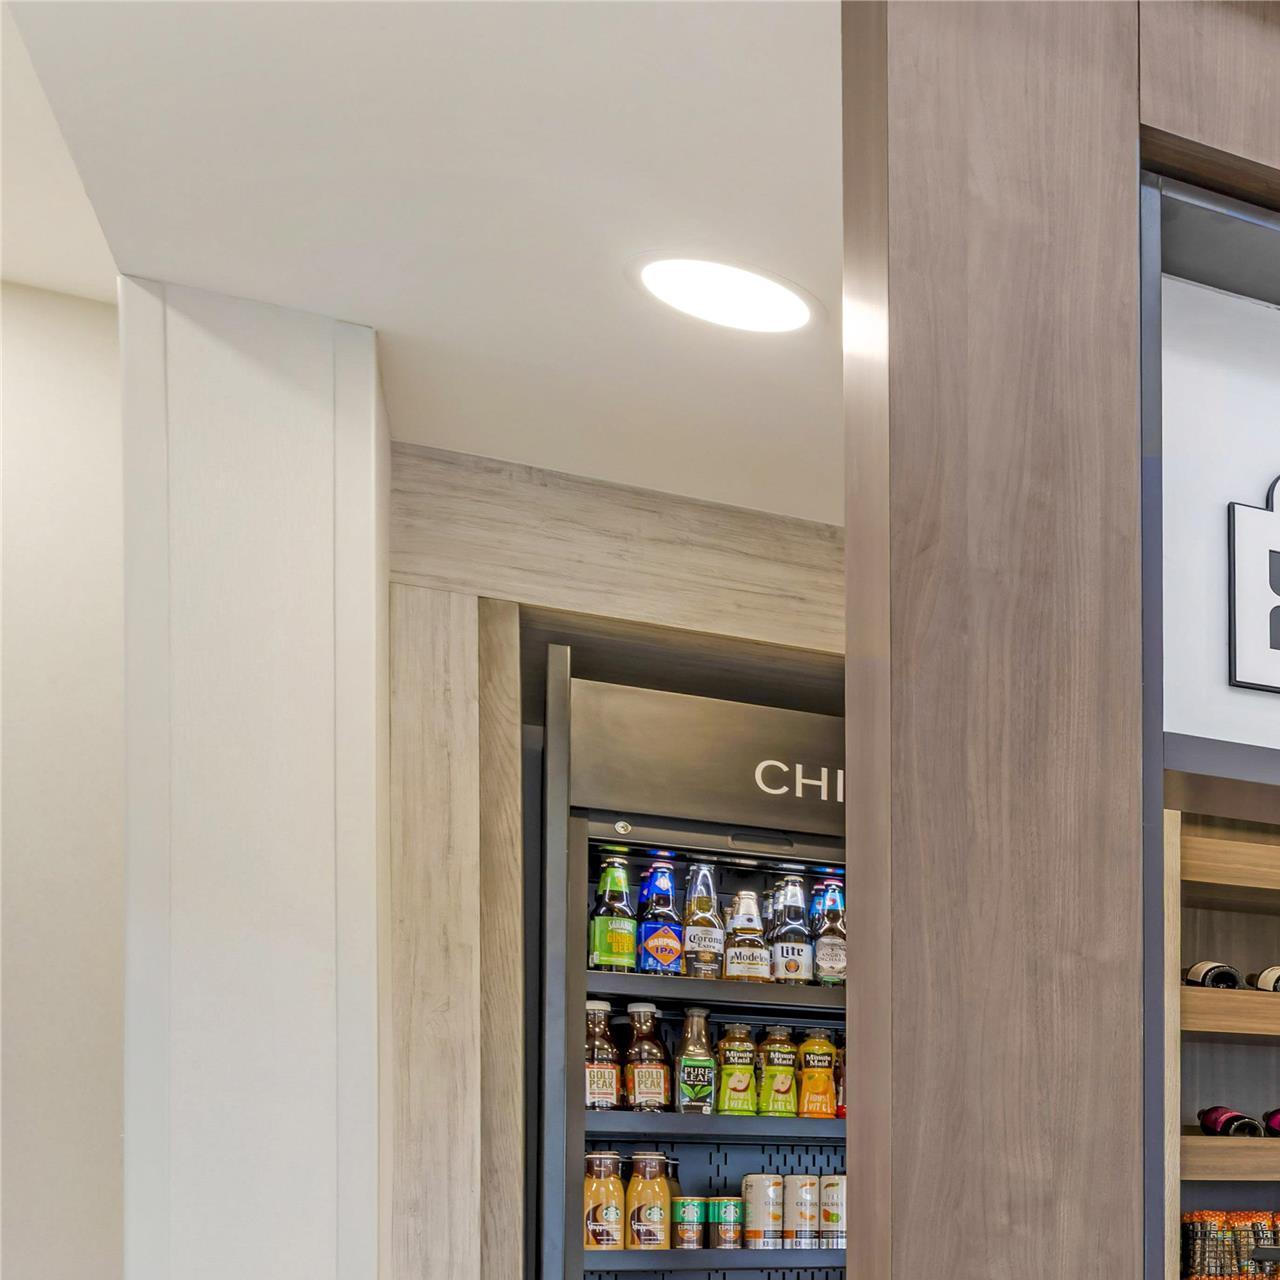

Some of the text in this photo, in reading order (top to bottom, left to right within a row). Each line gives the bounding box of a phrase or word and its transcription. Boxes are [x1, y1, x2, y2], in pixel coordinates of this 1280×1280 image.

[689, 933, 723, 944] Corona
[612, 943, 634, 953] BEER
[655, 946, 675, 955] IPA
[781, 945, 804, 958] Lite
[730, 950, 768, 962] Modelo
[726, 1050, 753, 1059] Minute
[770, 1051, 795, 1060] Minute
[806, 1053, 831, 1061] Minute
[729, 1056, 751, 1064] Maid
[774, 1057, 793, 1065] Maid
[809, 1059, 828, 1067] Maid
[589, 1070, 614, 1080] GOLD
[637, 1070, 662, 1080] GOLD
[684, 1067, 711, 1075] PURE
[589, 1080, 614, 1089] PEAK
[637, 1080, 662, 1089] PEAK
